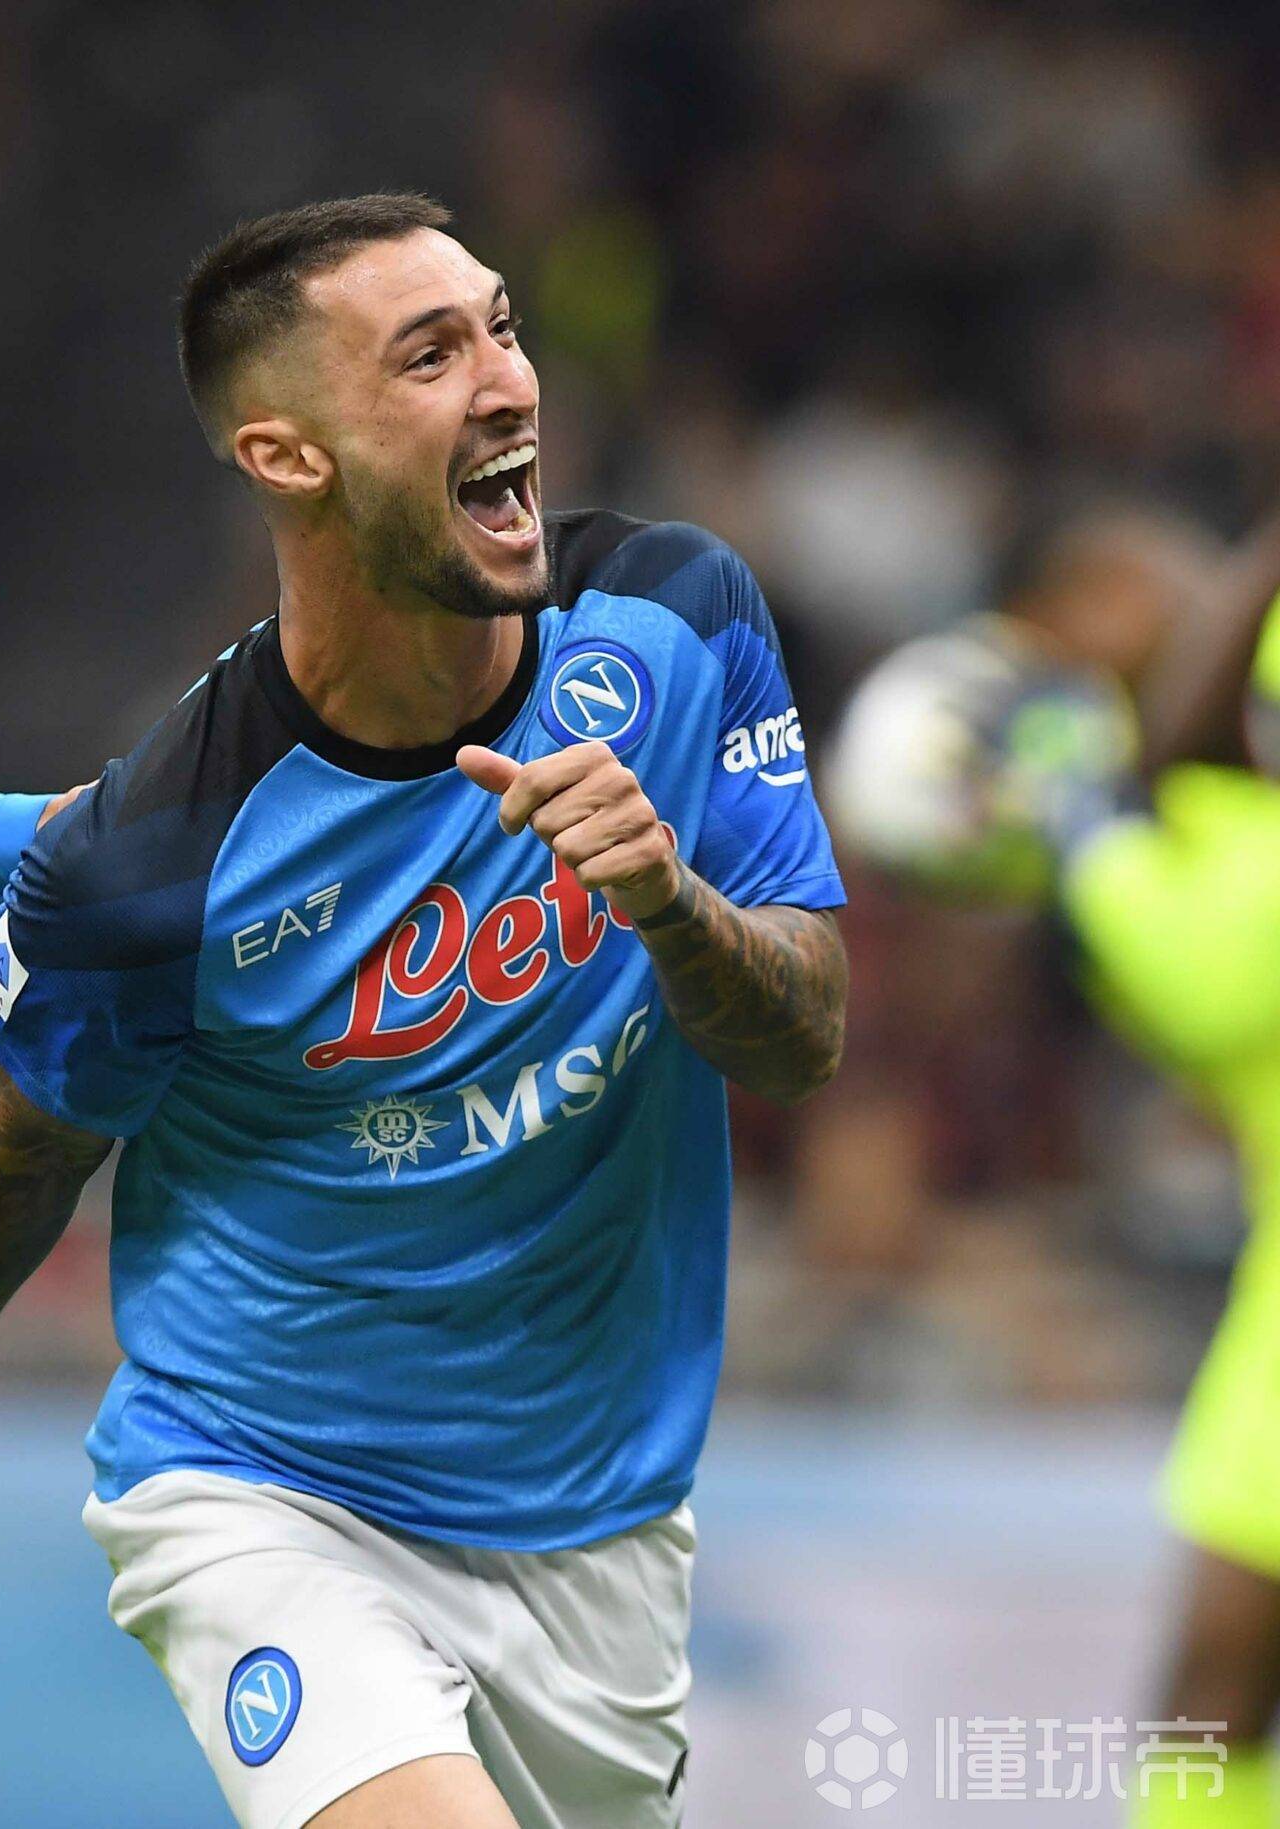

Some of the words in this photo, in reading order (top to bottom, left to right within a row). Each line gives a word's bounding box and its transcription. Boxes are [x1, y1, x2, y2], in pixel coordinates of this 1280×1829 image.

[560, 661, 627, 731] N
[232, 882, 343, 969] EA7
[302, 820, 678, 1071] Let
[234, 1669, 280, 1739] N
